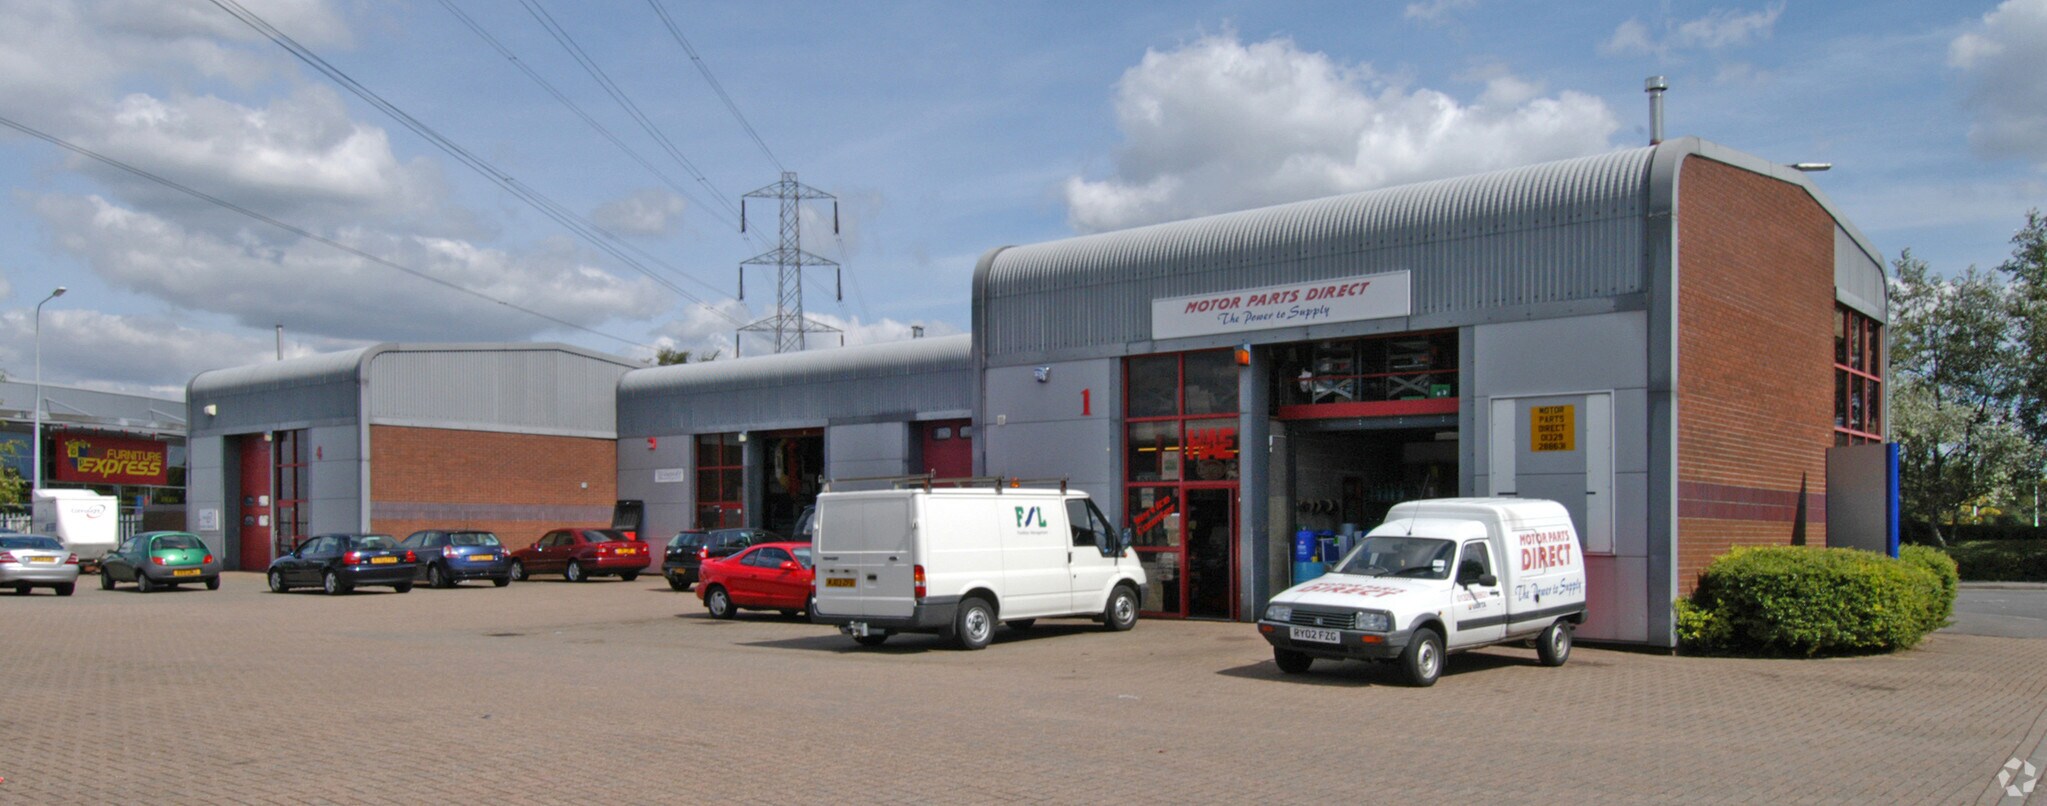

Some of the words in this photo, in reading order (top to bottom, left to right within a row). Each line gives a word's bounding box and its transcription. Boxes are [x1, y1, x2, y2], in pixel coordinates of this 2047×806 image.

[1184, 296, 1241, 313] MOTOR
[1246, 290, 1300, 307] PARTS
[1306, 282, 1371, 301] DIRECT
[1217, 312, 1239, 325] The
[1244, 310, 1274, 324] Power
[1276, 311, 1286, 319] to
[1287, 305, 1330, 320] Supply
[1081, 388, 1092, 416] 1
[1539, 406, 1564, 414] MOTOR
[1539, 415, 1564, 423] PARTS
[1538, 424, 1565, 432] DIRECT
[107, 449, 161, 460] FURNITURE
[1520, 532, 1547, 545] MOTOR
[1548, 530, 1570, 542] PARTS
[1521, 544, 1571, 571] DIRECT
[1515, 584, 1529, 601] The
[1559, 578, 1582, 597] Supply
[1293, 629, 1317, 640] RY02
[1319, 631, 1337, 641] FZG
